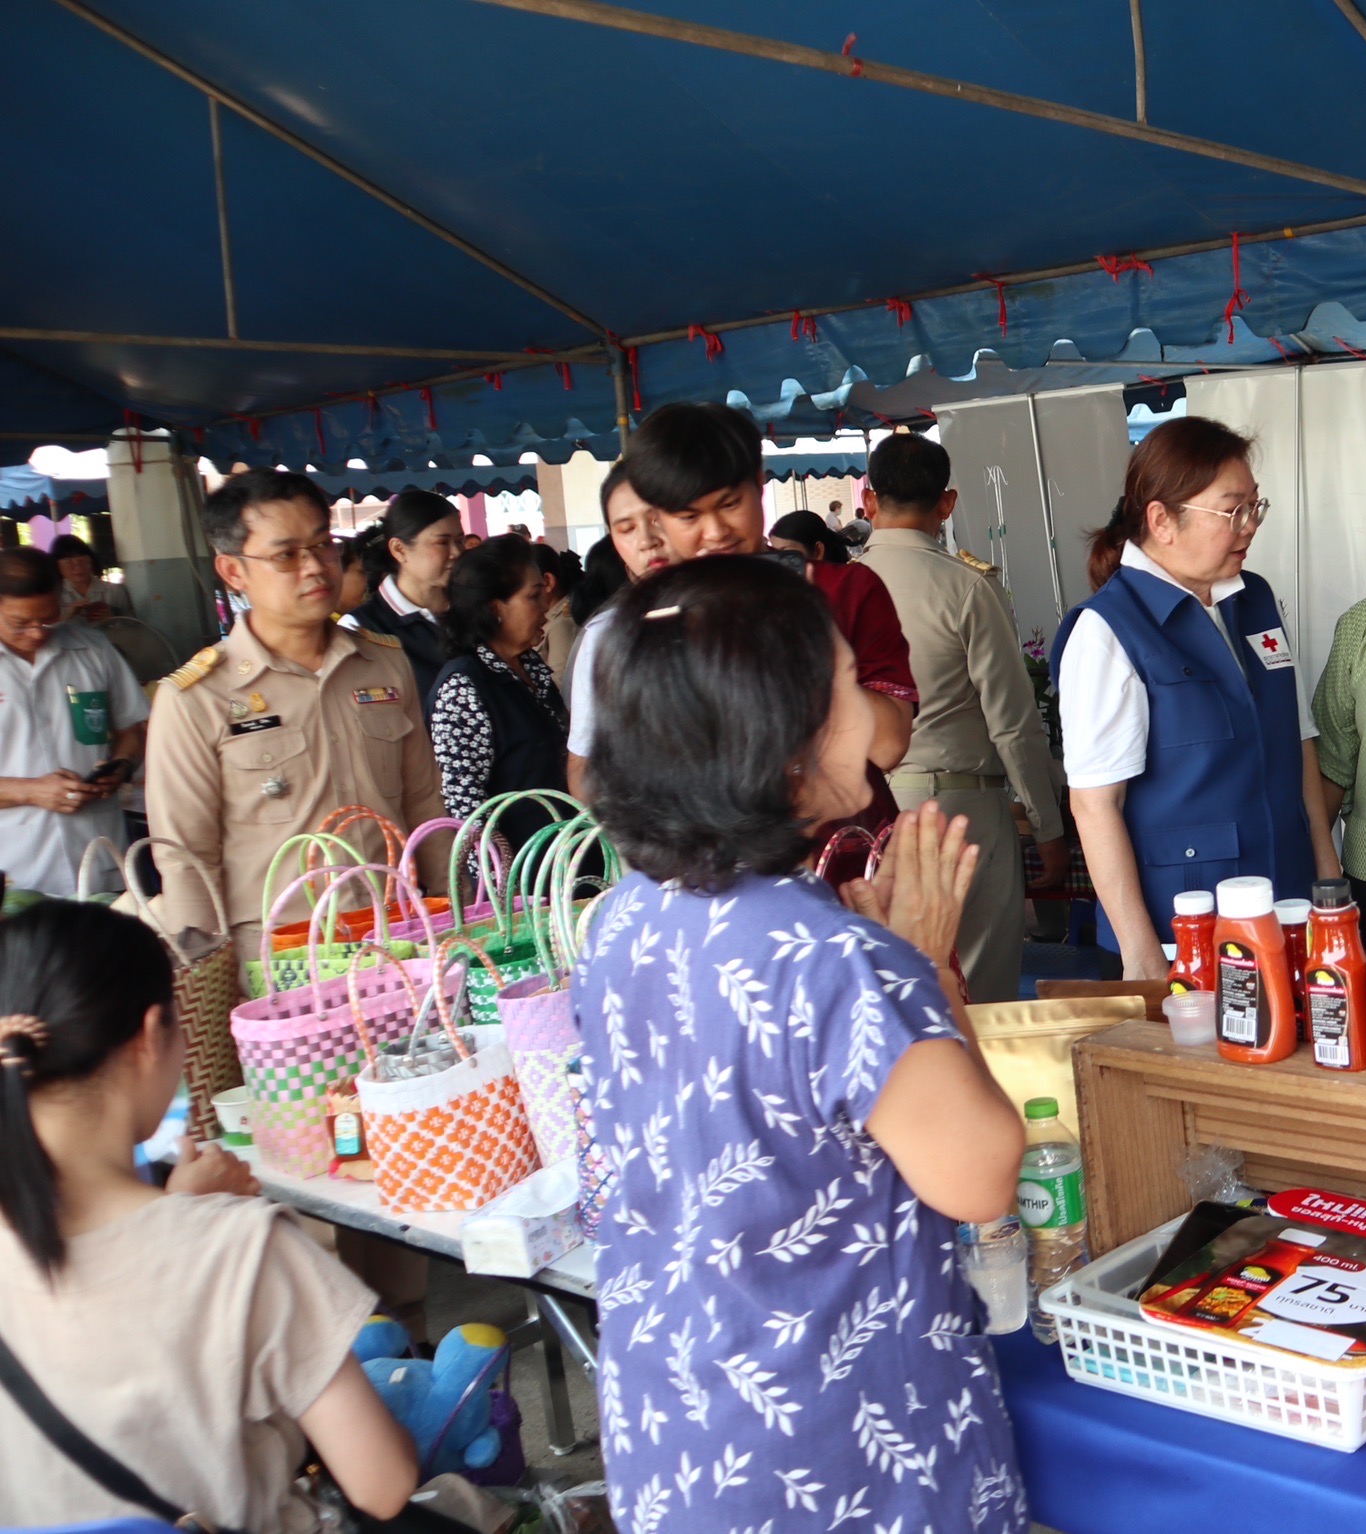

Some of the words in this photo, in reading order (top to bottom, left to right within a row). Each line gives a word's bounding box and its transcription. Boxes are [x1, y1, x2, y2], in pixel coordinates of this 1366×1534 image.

[1312, 1253, 1339, 1267] 400
[1340, 1259, 1359, 1271] ml.
[1289, 1273, 1358, 1305] 75
[1275, 1294, 1336, 1316] ทุกรสชาติ
